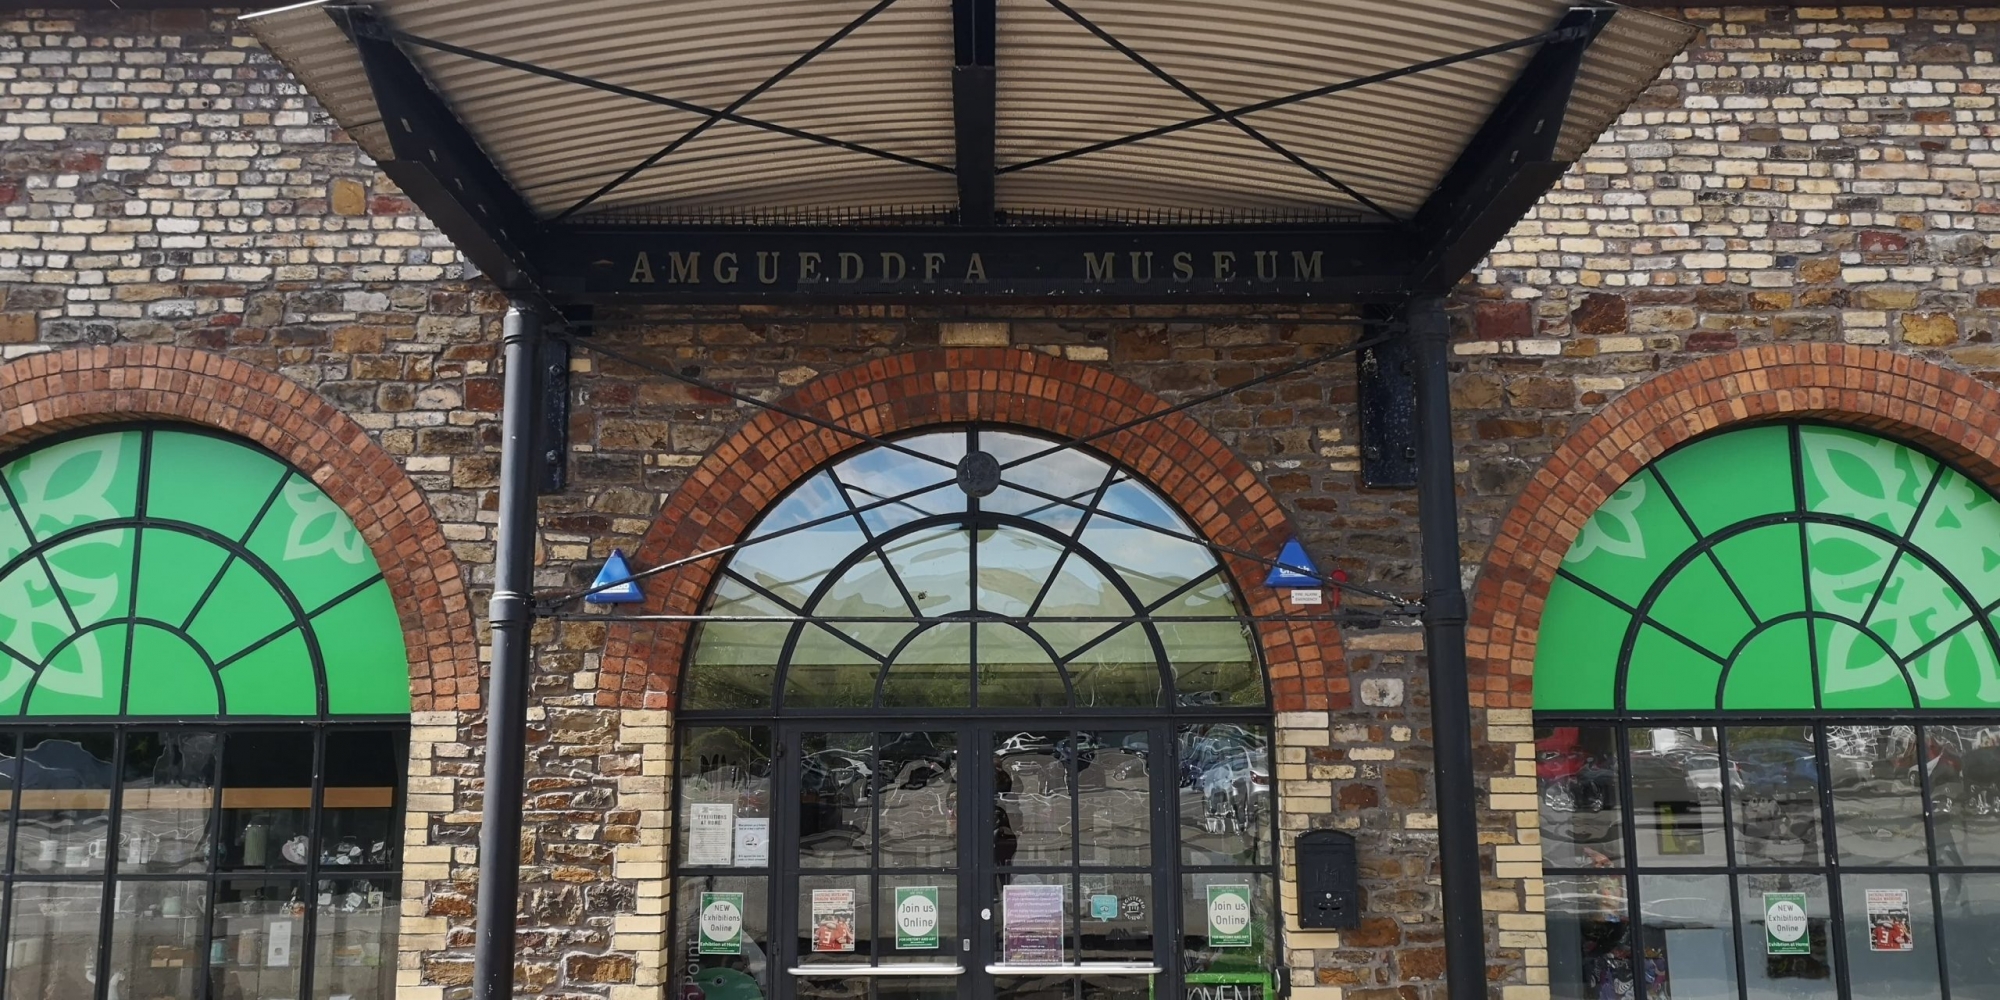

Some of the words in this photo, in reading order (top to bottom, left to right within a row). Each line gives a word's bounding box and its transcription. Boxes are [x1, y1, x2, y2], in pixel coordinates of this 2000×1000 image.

[629, 250, 988, 284] AMGUEDDFA
[1084, 250, 1325, 283] MUSEUM
[714, 904, 730, 912] NEW
[902, 903, 920, 914] Join
[923, 905, 934, 913] us
[1214, 901, 1232, 911] Join
[1235, 902, 1246, 911] us
[1777, 904, 1794, 912] NEW
[703, 914, 740, 922] Exhibitions
[903, 917, 933, 928] Online
[1216, 915, 1246, 925] Online
[1768, 914, 1806, 922] Exhibitions
[710, 924, 733, 932] Online
[1776, 924, 1799, 932] Online
[822, 931, 832, 944] 3
[1880, 931, 1890, 944] 3
